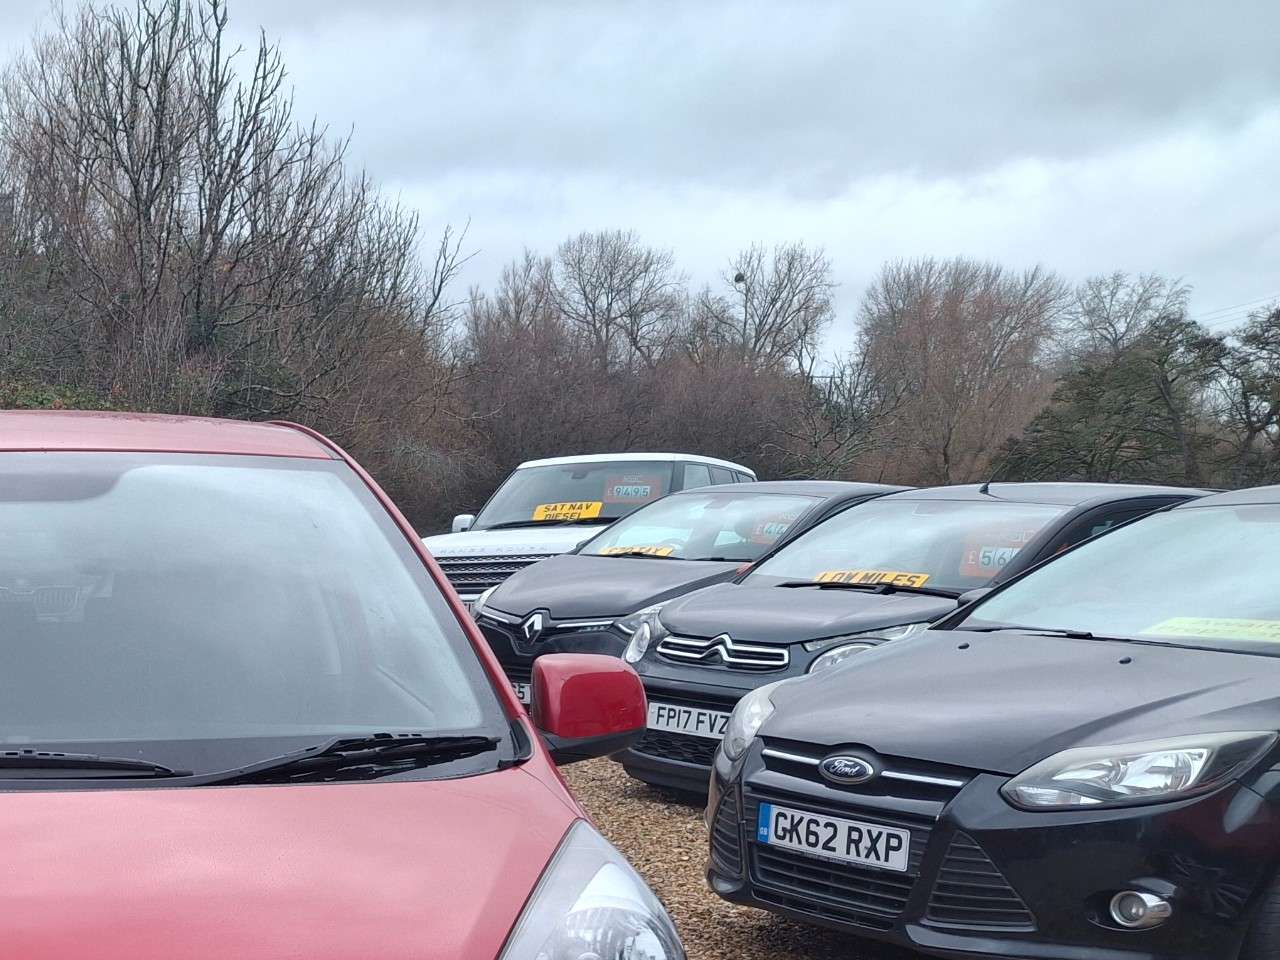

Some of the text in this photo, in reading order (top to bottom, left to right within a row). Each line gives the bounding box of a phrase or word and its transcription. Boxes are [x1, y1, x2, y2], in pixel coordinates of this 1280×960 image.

[544, 503, 593, 512] SAT NAV
[544, 512, 582, 520] DIESEL
[860, 572, 921, 586] MILES
[656, 706, 731, 735] FP17 FVZ
[831, 759, 860, 777] Ford
[774, 811, 838, 853] GK62
[846, 825, 903, 863] RXP
